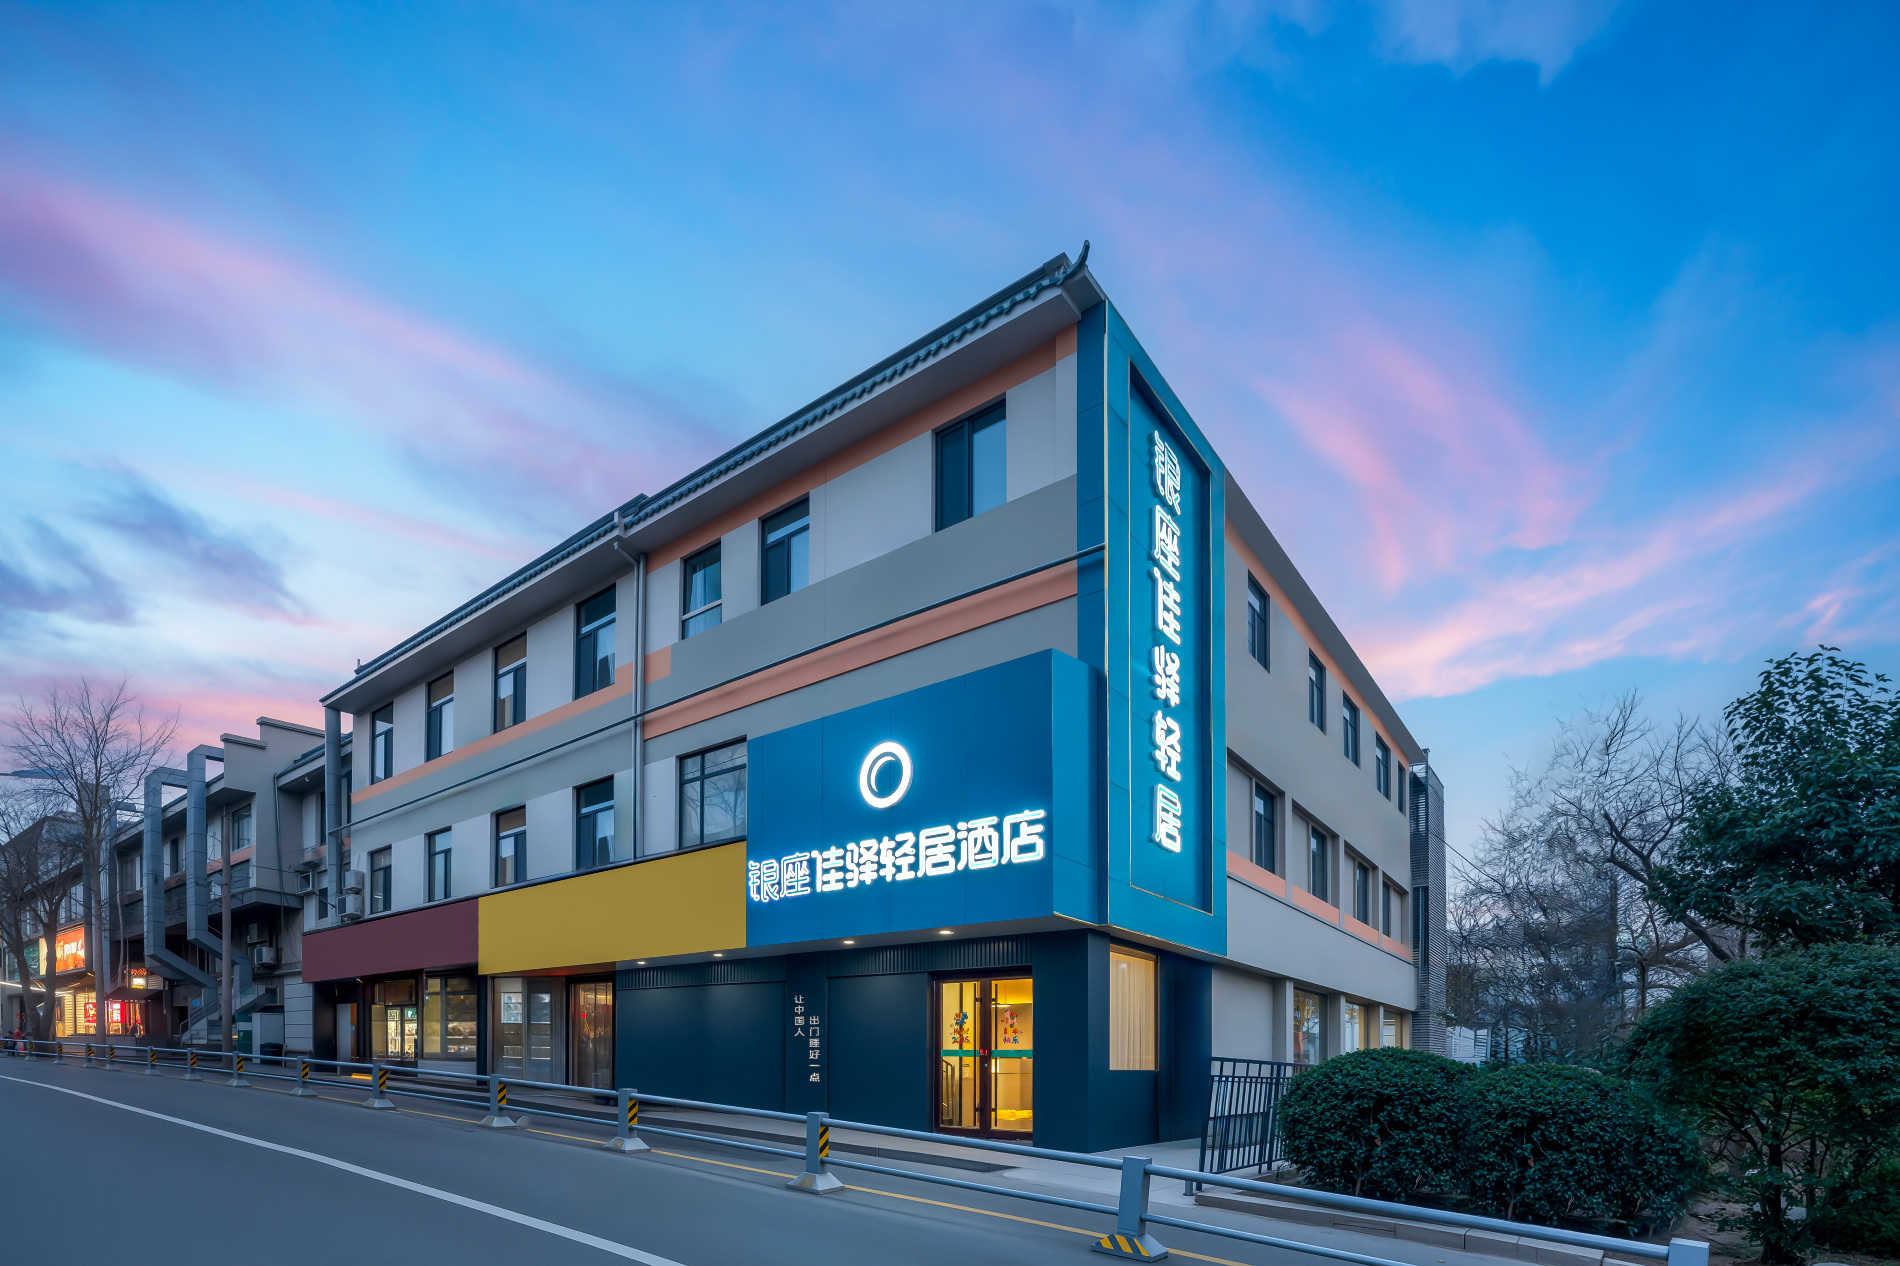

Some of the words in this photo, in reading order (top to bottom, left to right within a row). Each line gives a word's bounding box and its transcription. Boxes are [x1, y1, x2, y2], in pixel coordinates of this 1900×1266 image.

[1152, 430, 1181, 853] 银座佳驿轻居
[748, 809, 1047, 902] 银座佳驿轻居酒店
[793, 994, 805, 1037] 让中国人
[809, 1015, 821, 1082] 出门睡好一点
